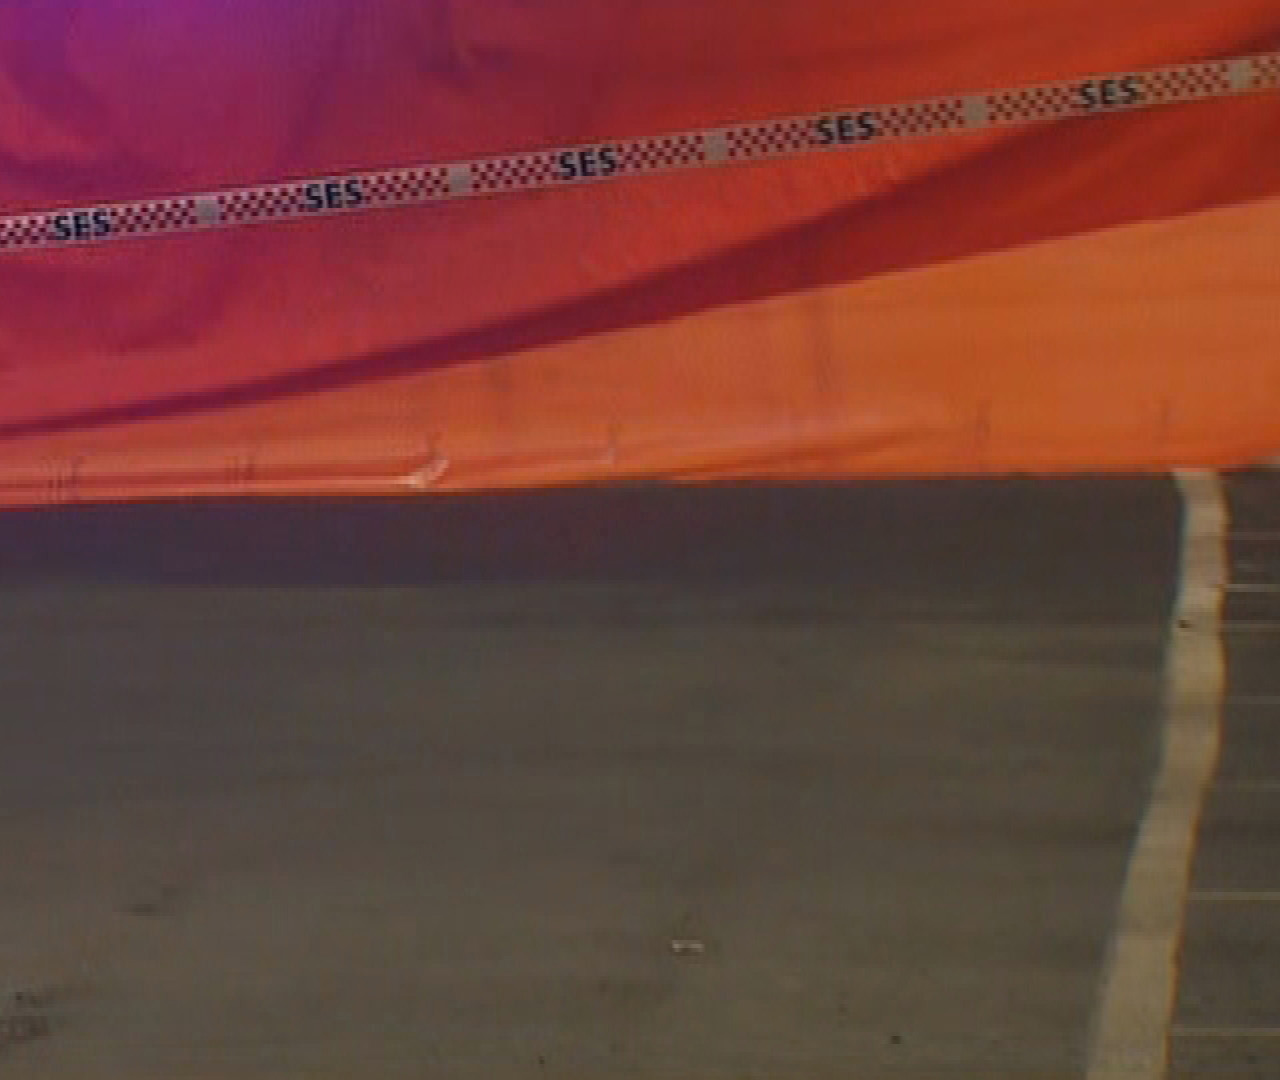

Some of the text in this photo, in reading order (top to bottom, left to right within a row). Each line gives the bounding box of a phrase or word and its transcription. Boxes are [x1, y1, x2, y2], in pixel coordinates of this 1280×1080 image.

[53, 210, 111, 241] SES
[304, 181, 363, 213] SES
[557, 147, 617, 179] SES
[816, 111, 875, 145] SES
[1079, 76, 1138, 109] SES
